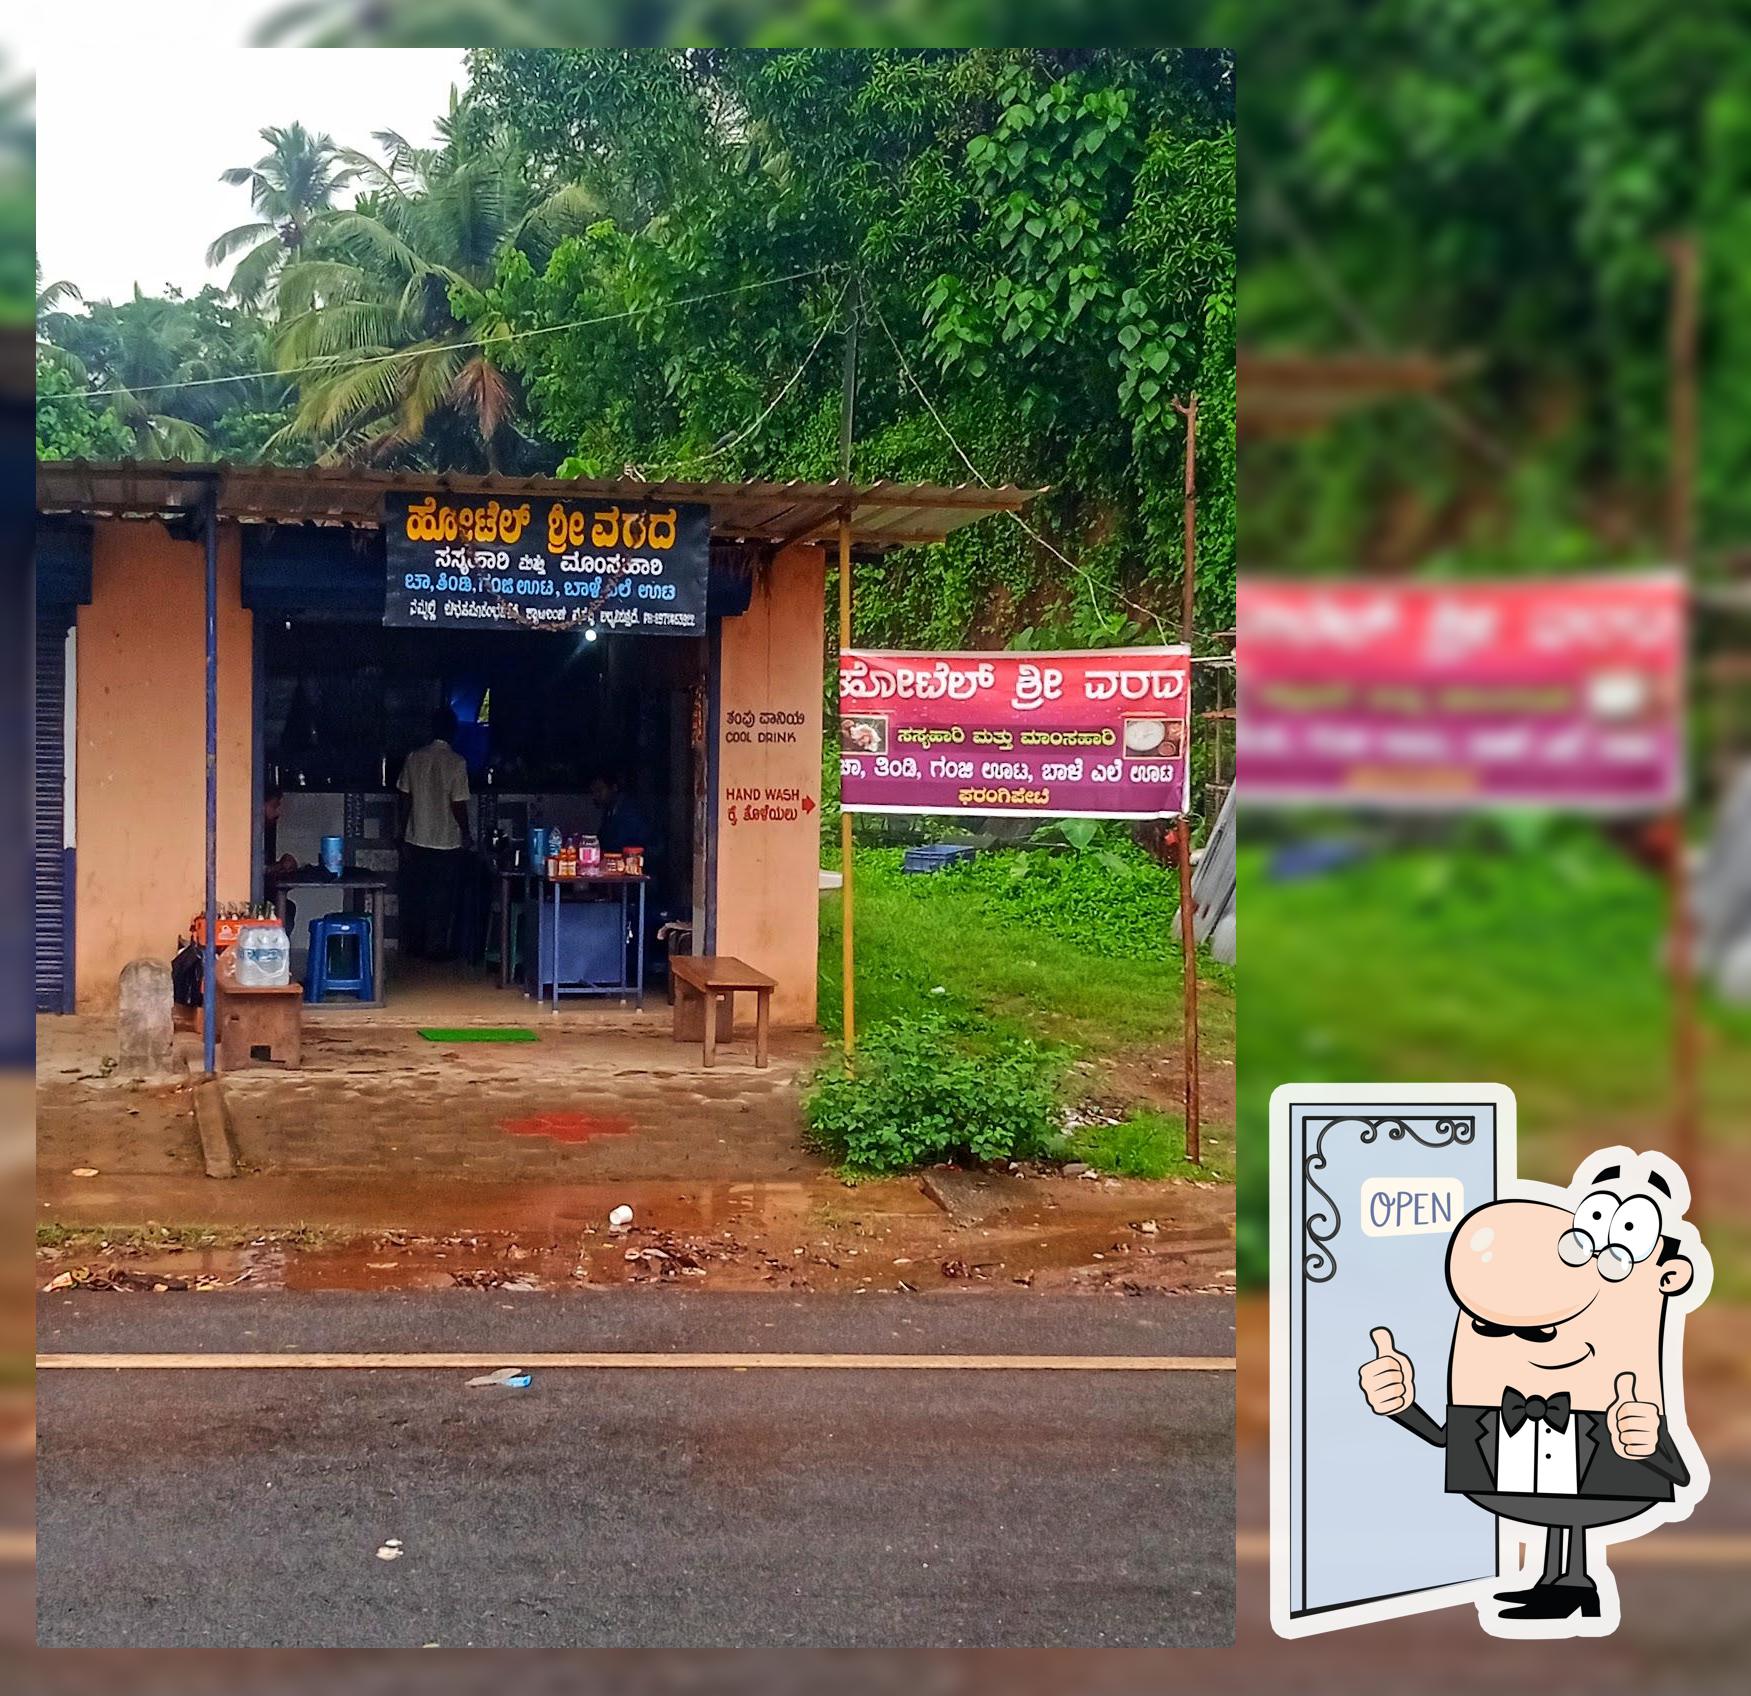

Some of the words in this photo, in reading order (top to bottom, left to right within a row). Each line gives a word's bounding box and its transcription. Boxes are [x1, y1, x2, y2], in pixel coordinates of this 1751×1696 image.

[406, 495, 532, 544] ಹೋಟೆಲ್
[547, 502, 585, 554] ಶ್ರೀ
[638, 582, 676, 601] ಊಟ
[840, 660, 996, 700] ಹೋಟೆಲ್
[1011, 663, 1063, 711] ಶ್ರೀ
[1084, 669, 1186, 700] ವರದ
[726, 709, 755, 728] ತಂಪು
[726, 731, 752, 743] COOL
[758, 731, 797, 743] DRINK
[897, 726, 966, 749] ಸಸ್ಯಹಾರಿ
[971, 728, 1014, 751] ಮತ್ತು
[1020, 728, 1117, 747] ಮಾಂಸಹಾರಿ
[874, 755, 922, 780] ತಿಂಡಿ,
[930, 755, 974, 778] ಗಂಜಿ
[981, 761, 1033, 784] ಊಟ,
[1041, 757, 1084, 782] ಬಾಳೆ
[1091, 758, 1124, 782] ಎಲೆ
[1130, 764, 1174, 783] ಊಟ
[726, 788, 761, 801] HAND
[765, 788, 800, 801] WASH
[958, 786, 1050, 806] ಫರಂಗಿಪೇಟೆ
